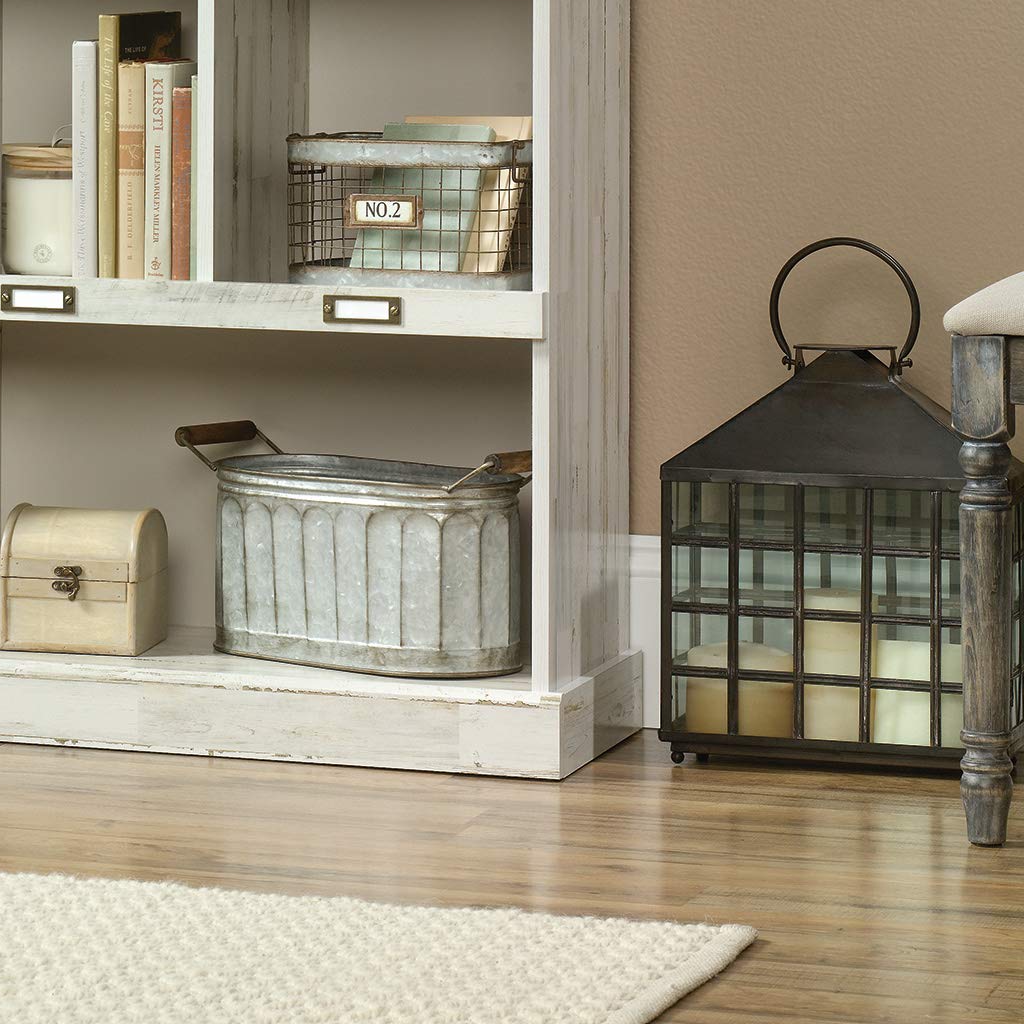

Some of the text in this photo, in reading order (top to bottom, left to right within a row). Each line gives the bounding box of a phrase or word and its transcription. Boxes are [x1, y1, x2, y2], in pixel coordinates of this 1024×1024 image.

[103, 37, 114, 54] The
[101, 57, 113, 76] Life
[101, 79, 113, 90] of
[103, 93, 114, 107] the
[152, 78, 164, 131] KIRSTI
[152, 145, 161, 243] HELEN MARKLEY MILLER
[366, 202, 401, 218] NO.2
